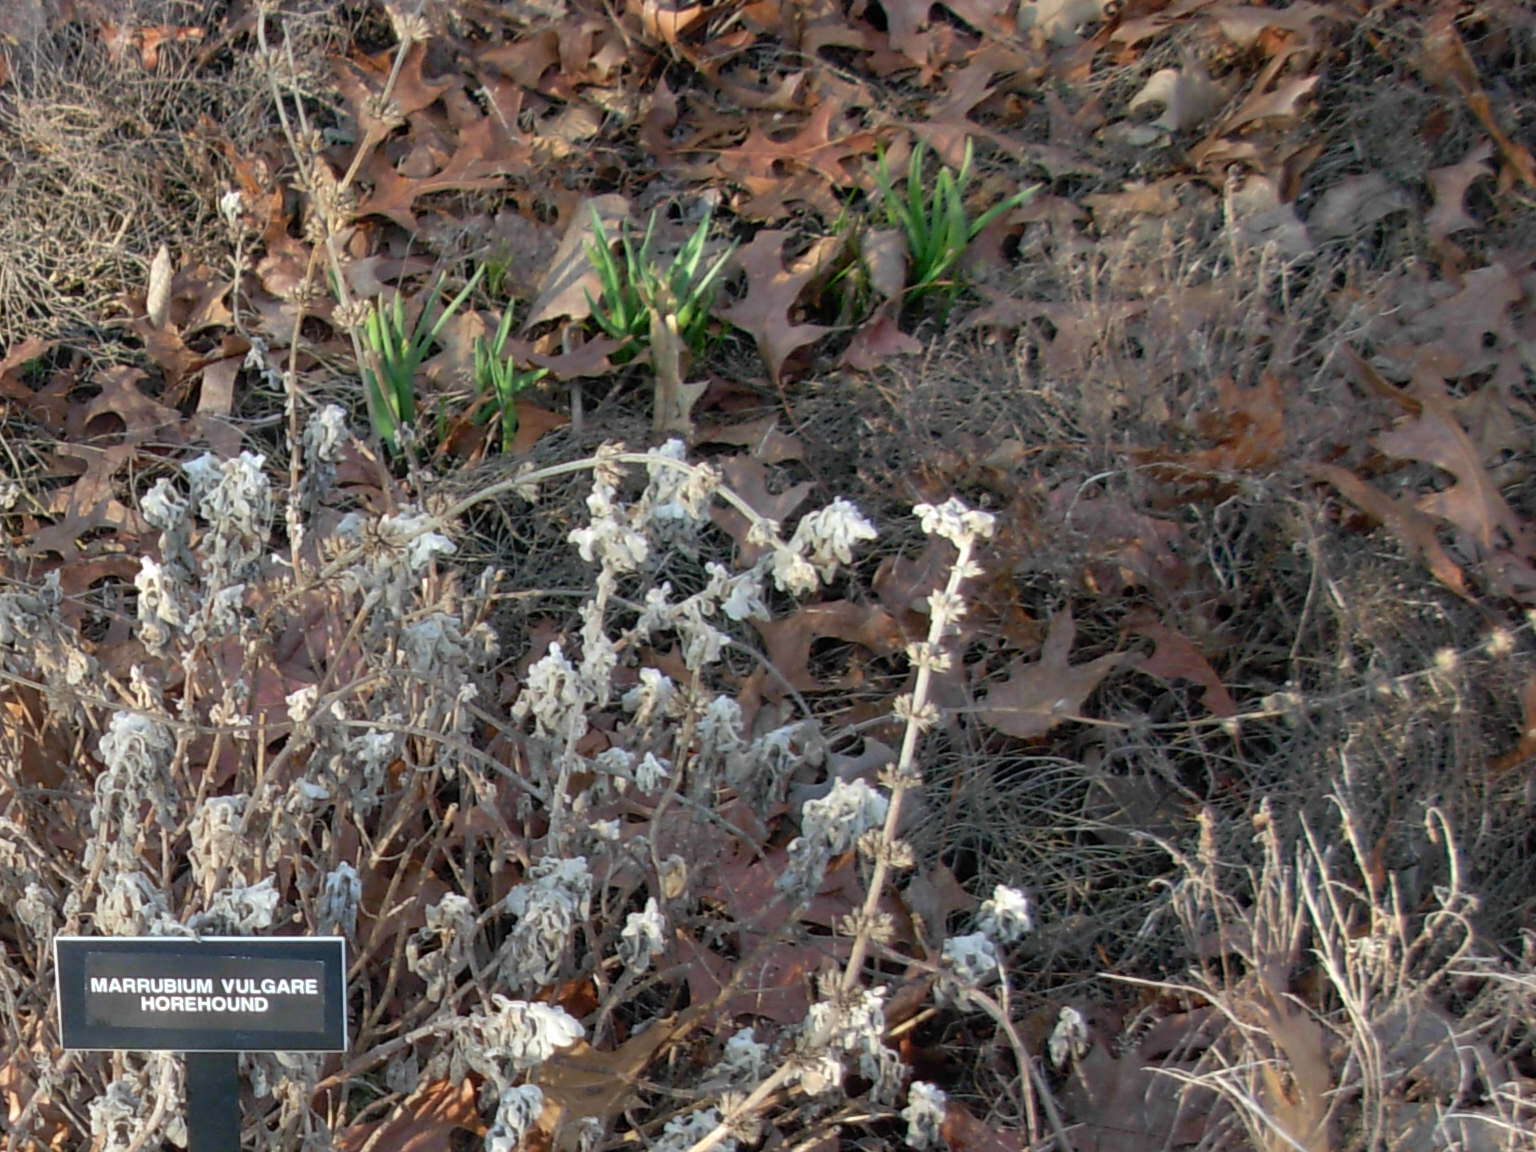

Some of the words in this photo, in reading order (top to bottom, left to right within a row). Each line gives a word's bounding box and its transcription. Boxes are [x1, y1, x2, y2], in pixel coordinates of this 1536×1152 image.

[90, 977, 213, 995] MARRUBIUM
[221, 978, 319, 995] VULGARE
[140, 996, 269, 1013] HOREHOUND
